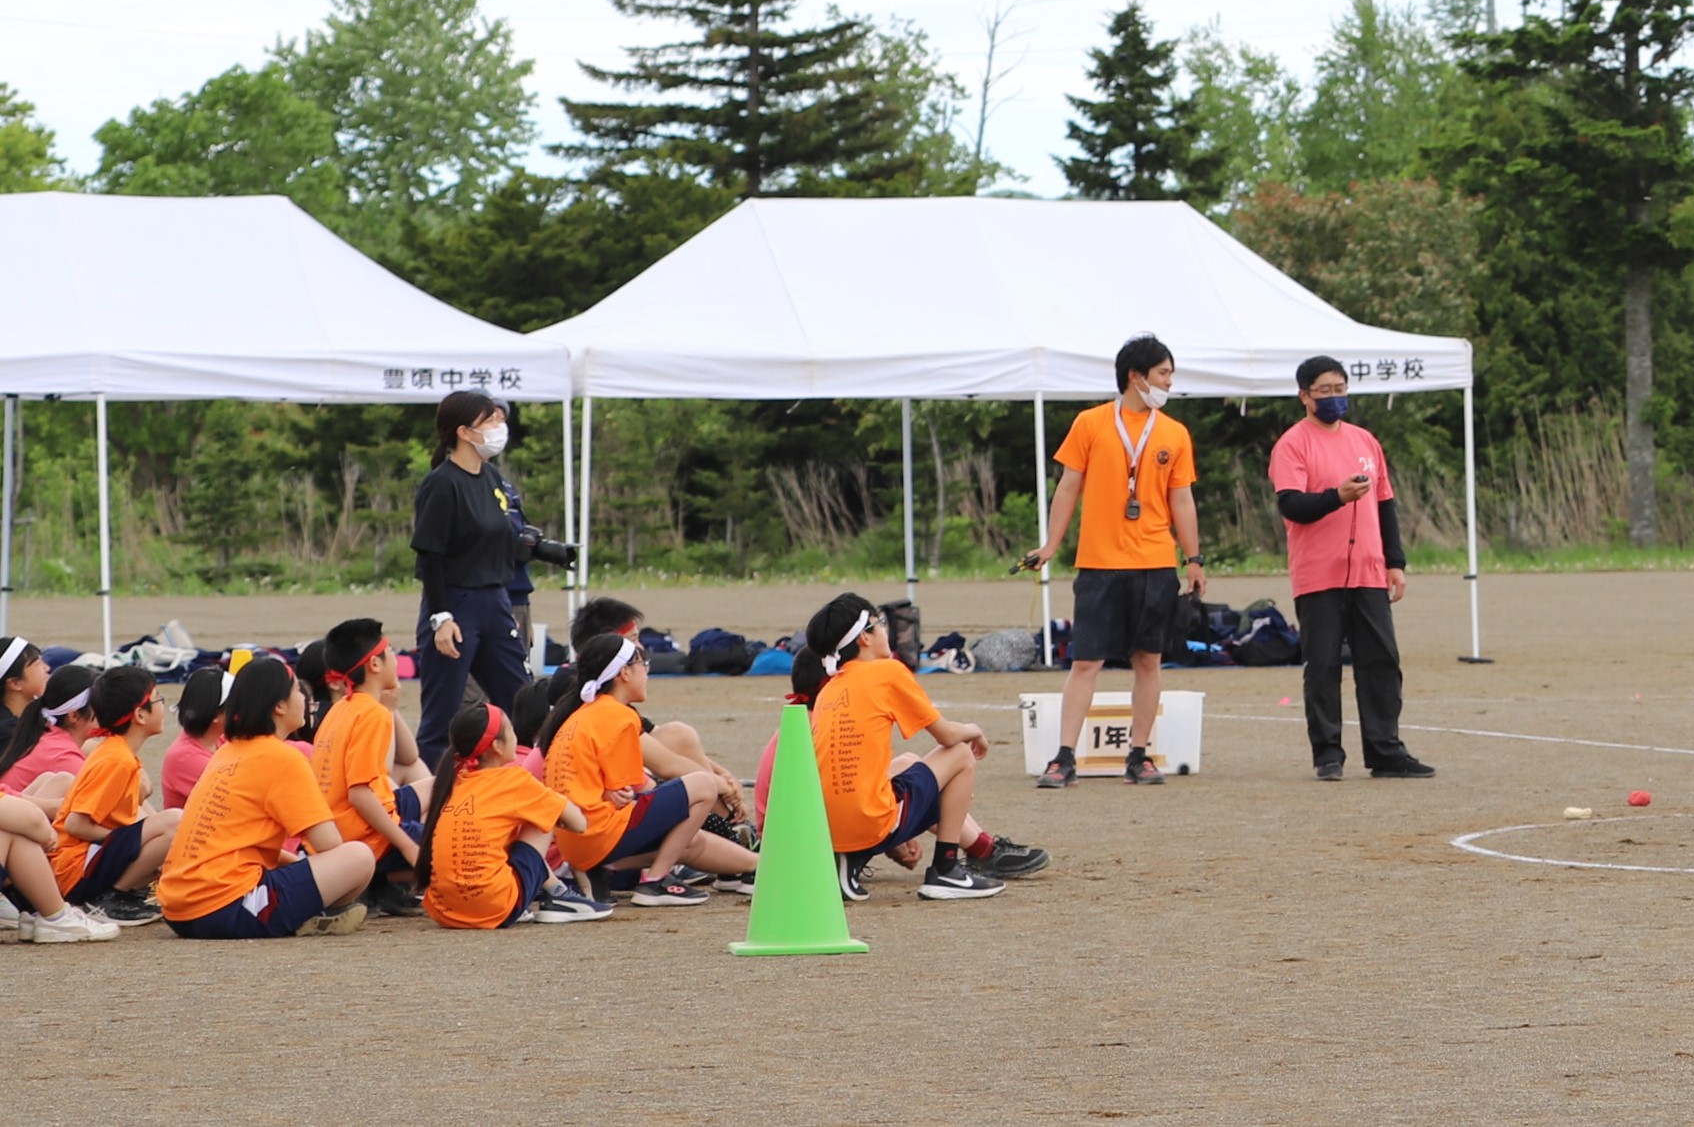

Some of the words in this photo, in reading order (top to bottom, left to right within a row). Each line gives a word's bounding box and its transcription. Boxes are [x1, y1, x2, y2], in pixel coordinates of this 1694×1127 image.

[383, 367, 522, 390] 豊頃中学校
[1338, 358, 1424, 381] 中学校
